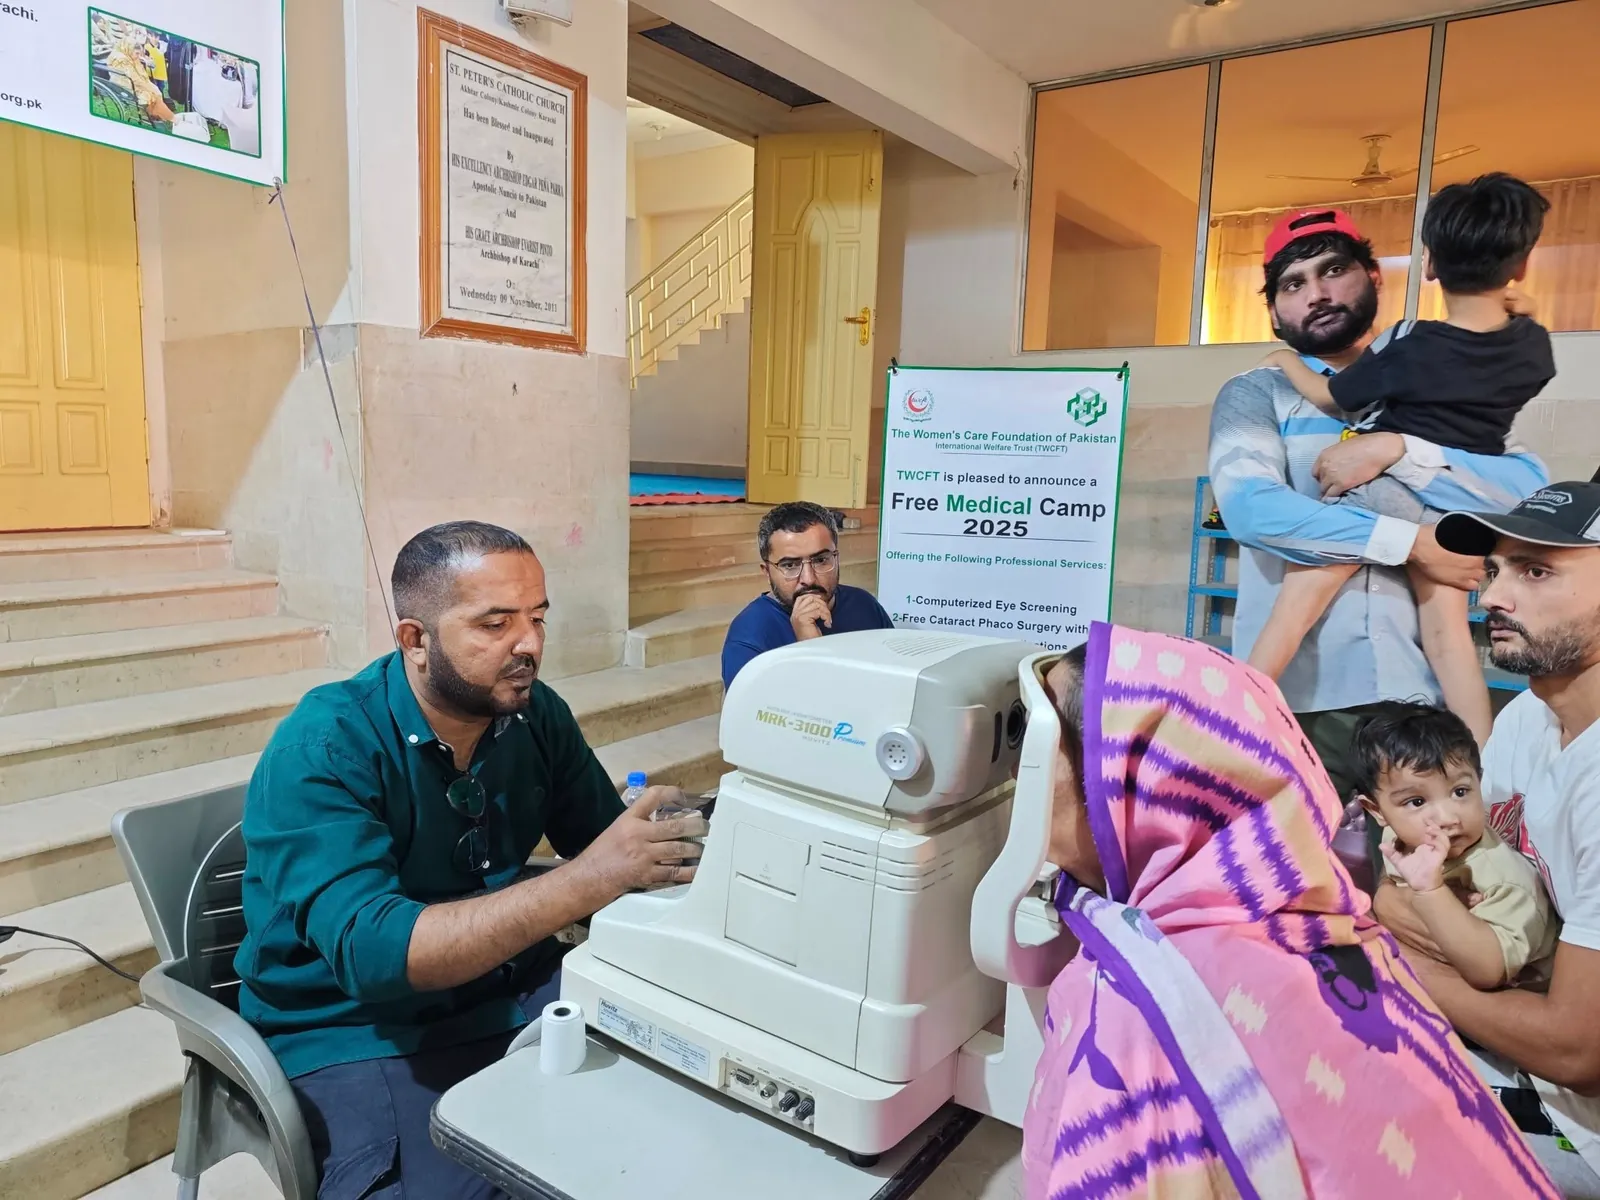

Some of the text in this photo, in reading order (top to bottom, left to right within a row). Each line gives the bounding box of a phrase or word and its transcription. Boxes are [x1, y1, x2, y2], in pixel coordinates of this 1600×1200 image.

[450, 63, 565, 115] ST. PETER'S CATHOLIC CHURCH
[0, 93, 42, 110] org.pk
[464, 107, 475, 119] Has
[476, 112, 489, 124] been
[512, 126, 522, 136] and
[452, 153, 460, 168] HIS
[461, 155, 492, 177] EXCELLENCY
[507, 150, 514, 163] By
[472, 180, 547, 208] Apostolic Nuncio to Pakistan
[505, 208, 516, 218] And
[465, 225, 473, 239] HIS
[492, 231, 520, 249] ARCHBISHOP
[480, 249, 540, 269] Archbishop of Karachi
[460, 286, 497, 304] Wednesday
[500, 294, 507, 303] 09
[544, 301, 557, 312] 2011
[892, 429, 1116, 444] The Women's Care Foundation of Pakistan
[935, 442, 982, 450] International
[984, 443, 1012, 451] Welfare
[1035, 445, 1068, 453] (TWCFT)
[897, 470, 1097, 486] TWCFT is pleased to announce a
[892, 492, 1106, 522] Free Medical Camp
[963, 519, 1028, 536] 2025
[886, 551, 1106, 570] Offering the Following Professional Services:
[906, 595, 1077, 616] 1-Computerized Eye Screening
[892, 613, 1088, 634] 2-Free Cataract Phaco Surgery with
[756, 710, 832, 738] MRK-3100
